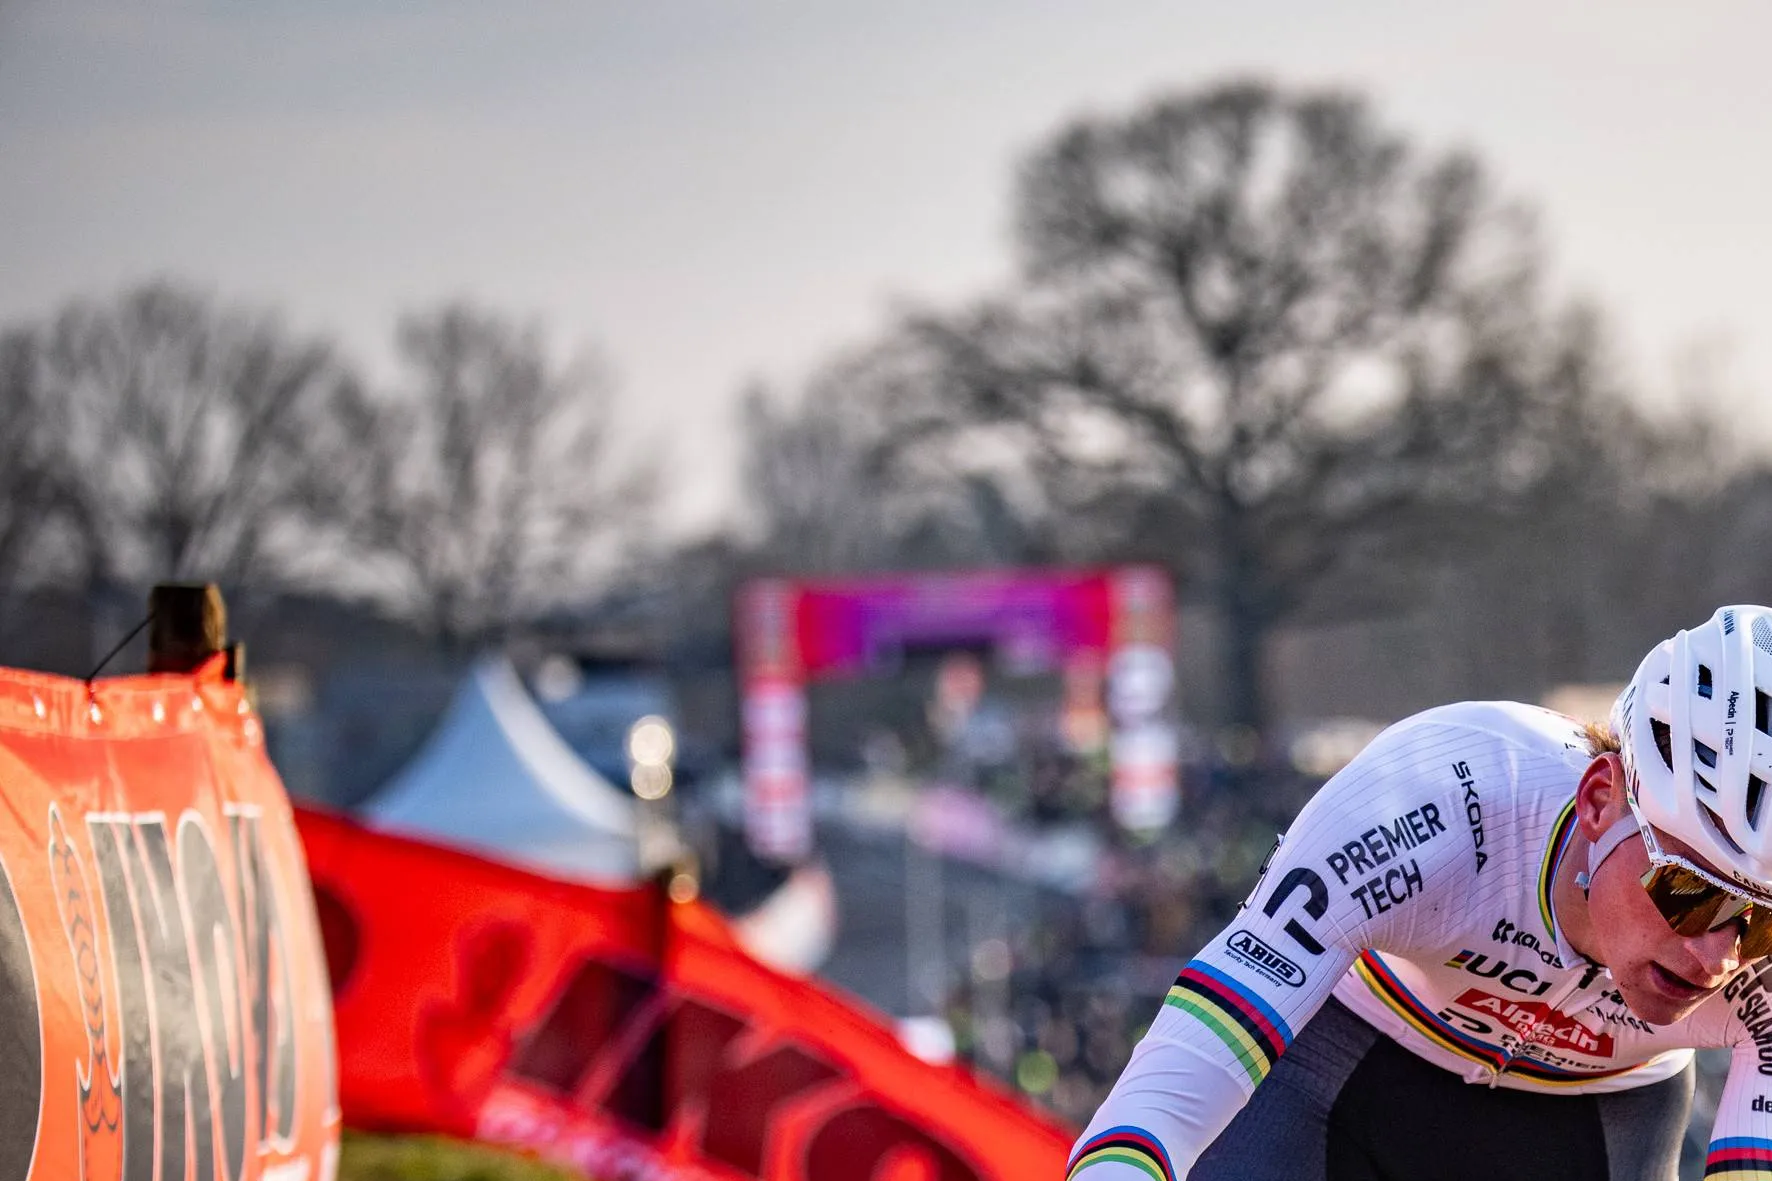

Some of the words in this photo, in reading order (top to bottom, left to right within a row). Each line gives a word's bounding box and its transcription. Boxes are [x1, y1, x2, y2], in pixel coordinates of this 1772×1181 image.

[1326, 803, 1446, 886] PREMIER
[1350, 859, 1423, 920] TECH
[1234, 936, 1297, 979] ABUS
[1466, 955, 1553, 996] UCI
[1472, 997, 1600, 1052] Alpecin
